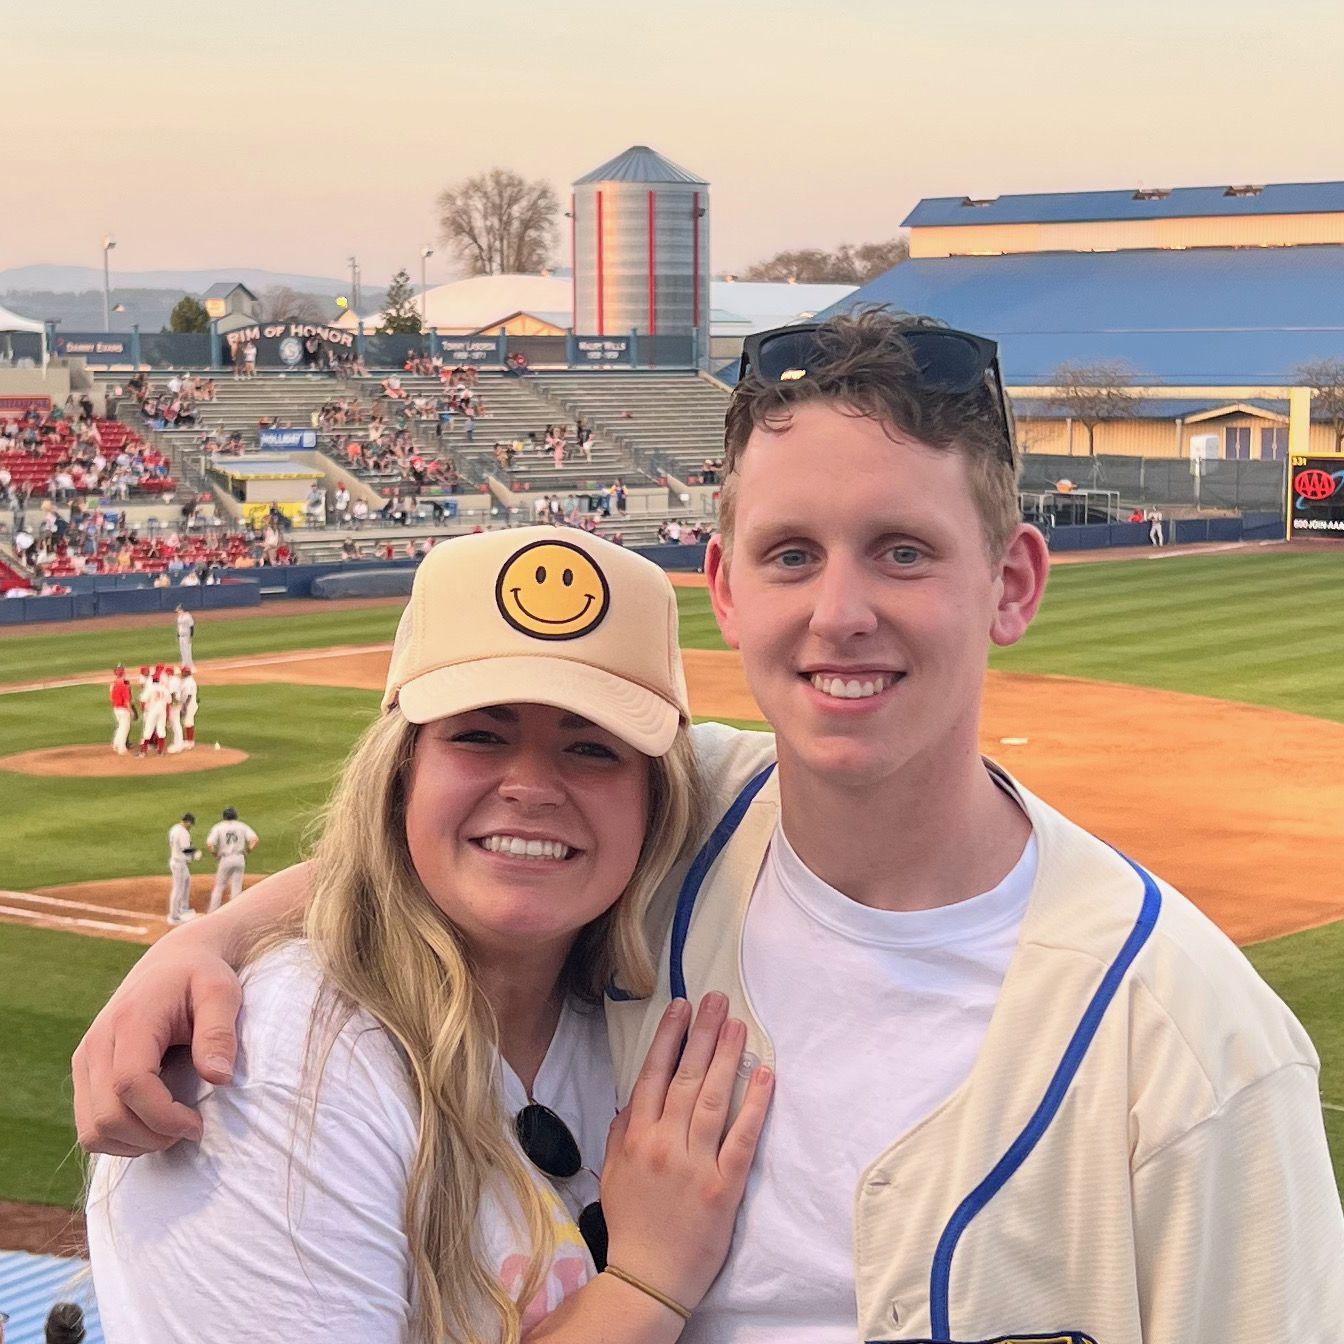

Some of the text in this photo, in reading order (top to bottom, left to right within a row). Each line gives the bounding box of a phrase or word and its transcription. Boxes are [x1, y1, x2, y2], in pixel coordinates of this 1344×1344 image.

[264, 325, 285, 338] OF
[290, 324, 353, 347] HONOR
[1298, 472, 1332, 498] AAA
